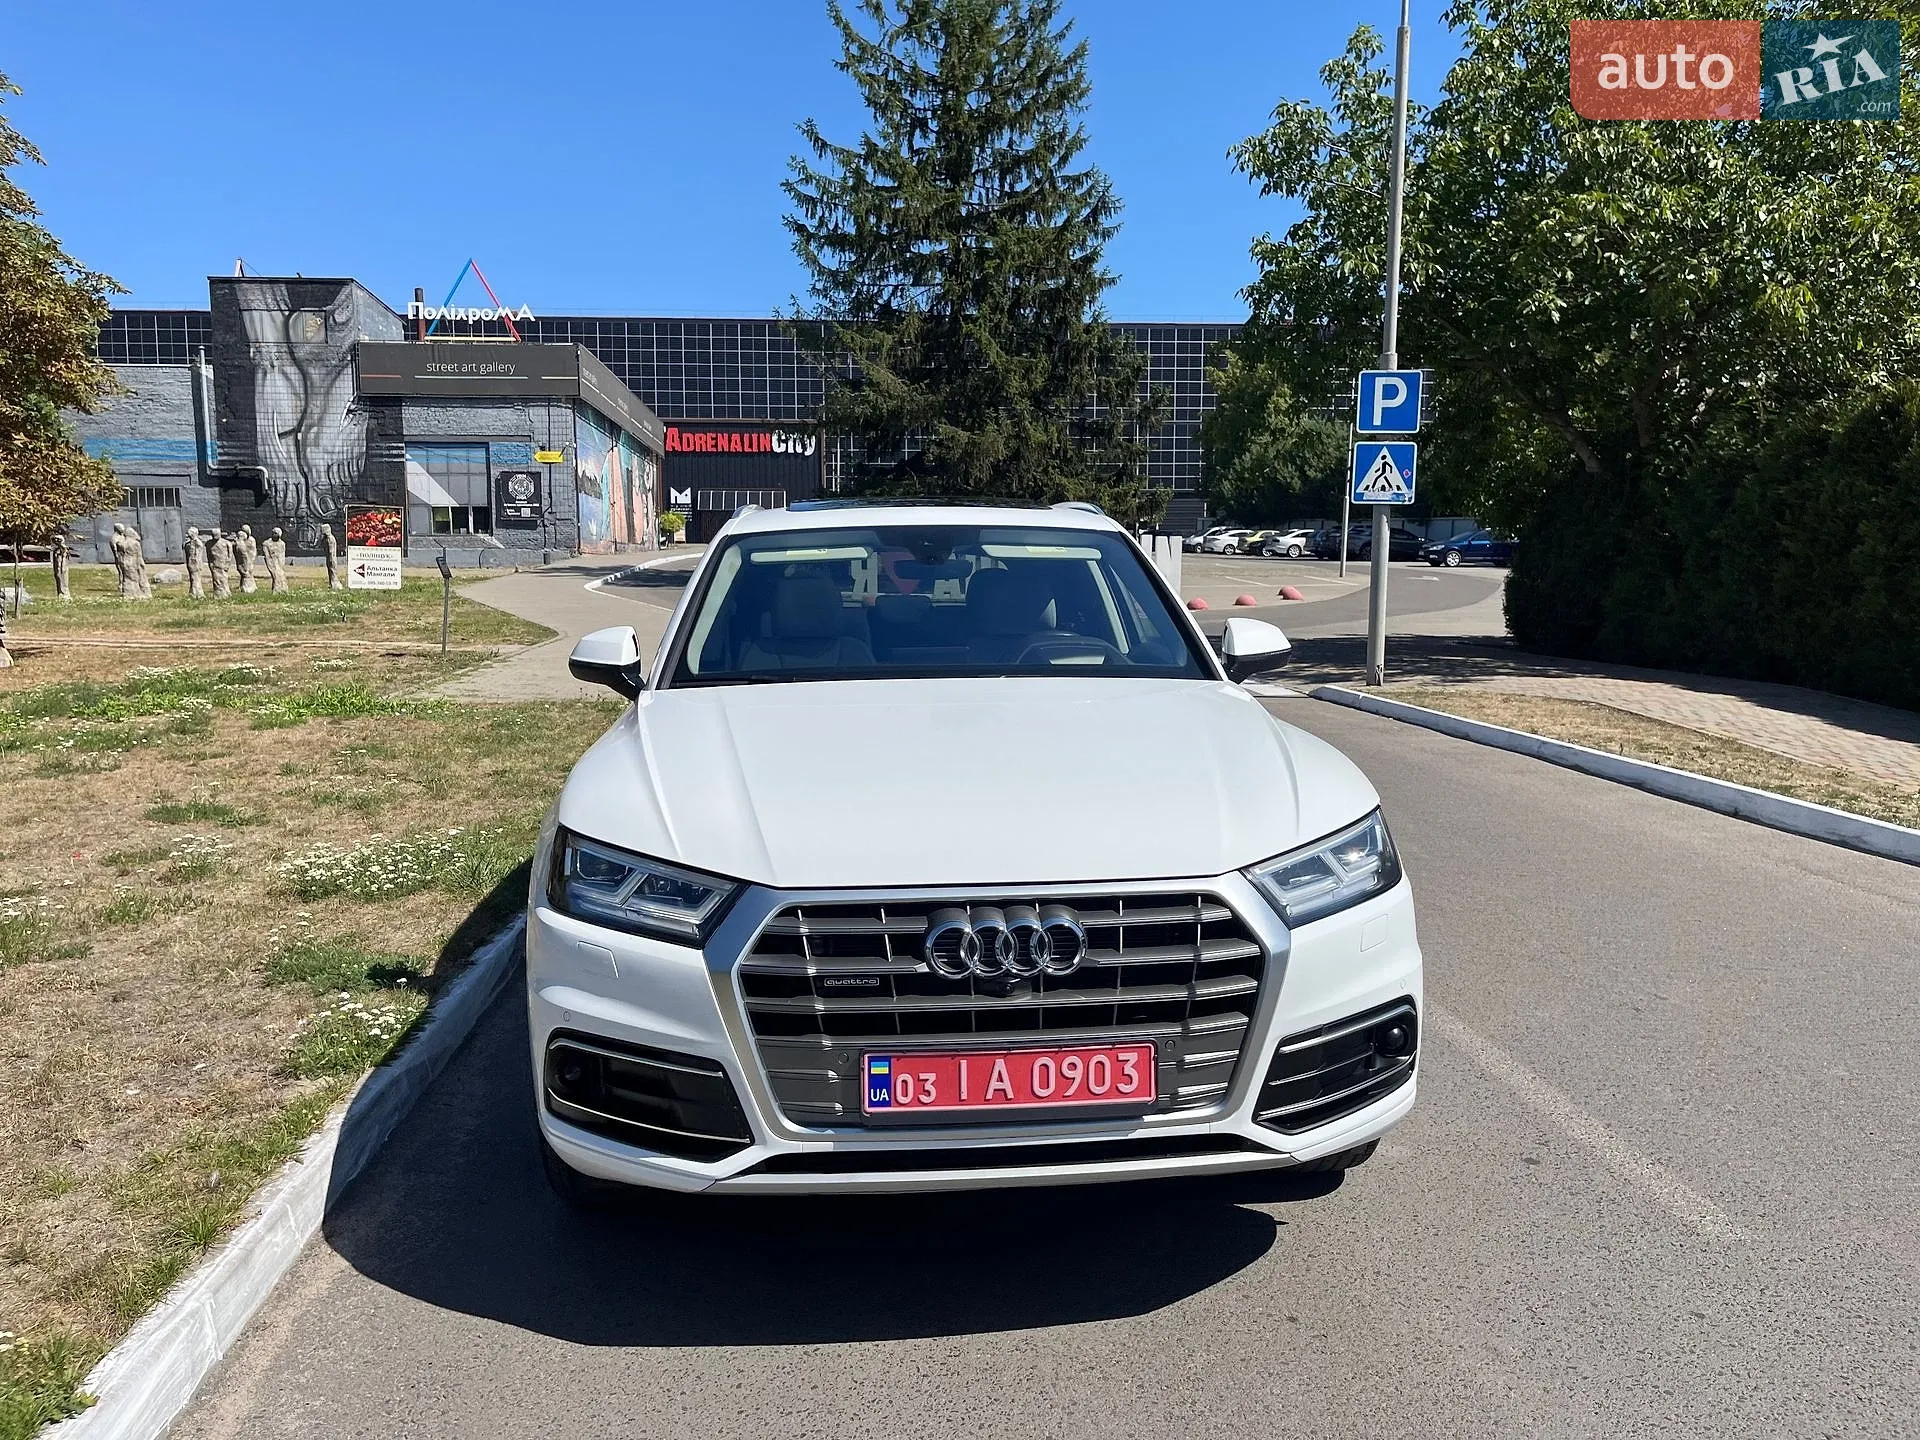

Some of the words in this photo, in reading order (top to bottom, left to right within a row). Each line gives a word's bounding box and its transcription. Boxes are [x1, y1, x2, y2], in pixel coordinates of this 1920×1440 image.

[426, 363, 458, 373] street
[461, 363, 477, 373] art
[479, 362, 515, 374] gallery
[1373, 377, 1407, 426] P
[826, 978, 877, 986] quattro
[894, 1073, 937, 1105] 03
[1032, 1052, 1140, 1098] 0903
[870, 1088, 890, 1102] UA
